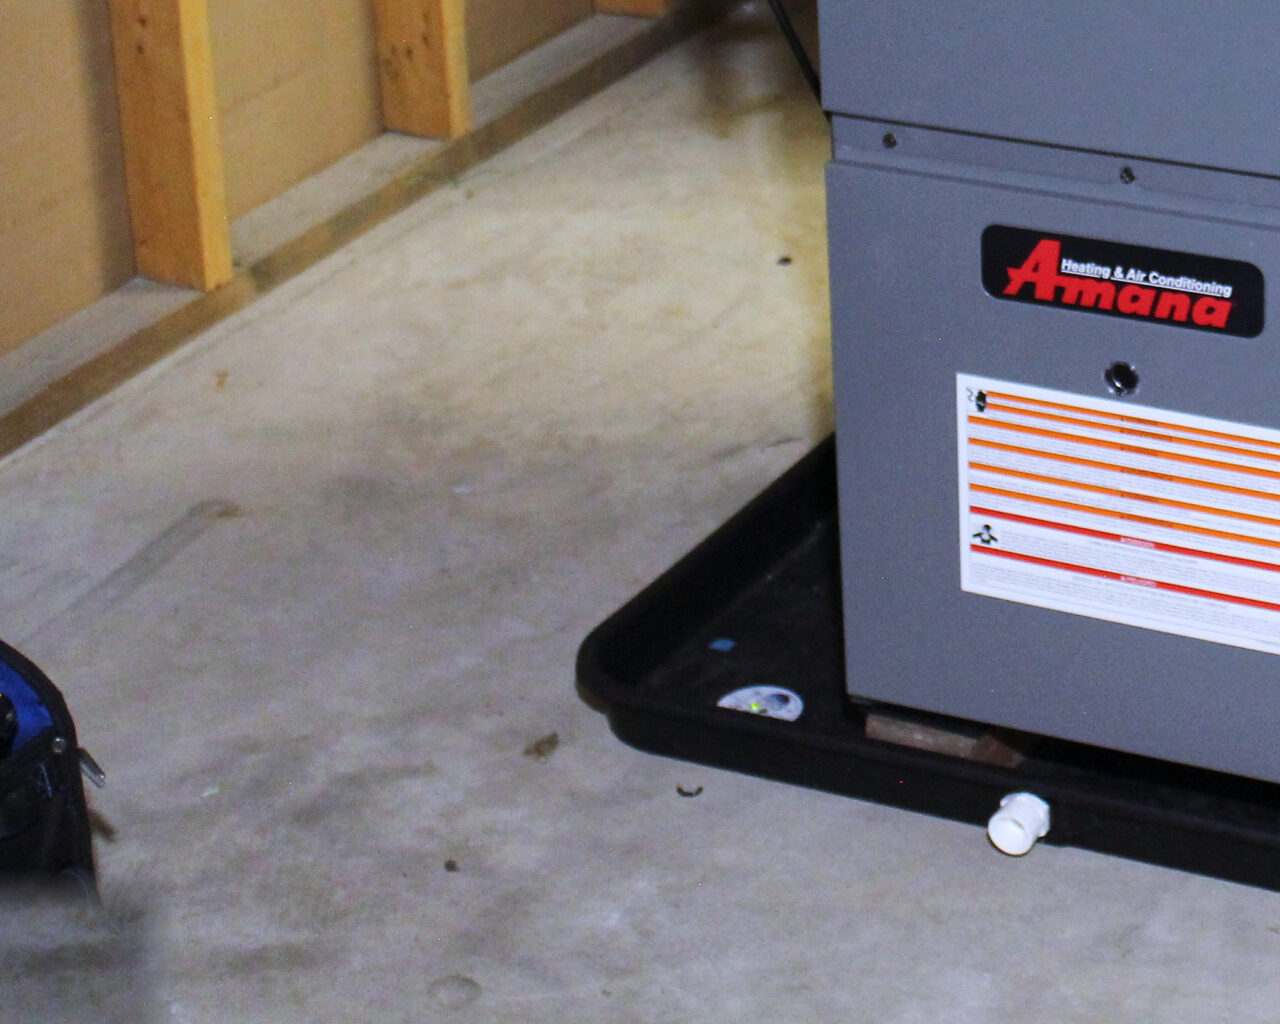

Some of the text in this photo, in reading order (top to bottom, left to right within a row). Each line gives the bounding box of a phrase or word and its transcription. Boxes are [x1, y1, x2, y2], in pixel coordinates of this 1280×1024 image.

[1002, 238, 1233, 329] Amana
[1061, 258, 1233, 299] Heating & Air Conditioning
